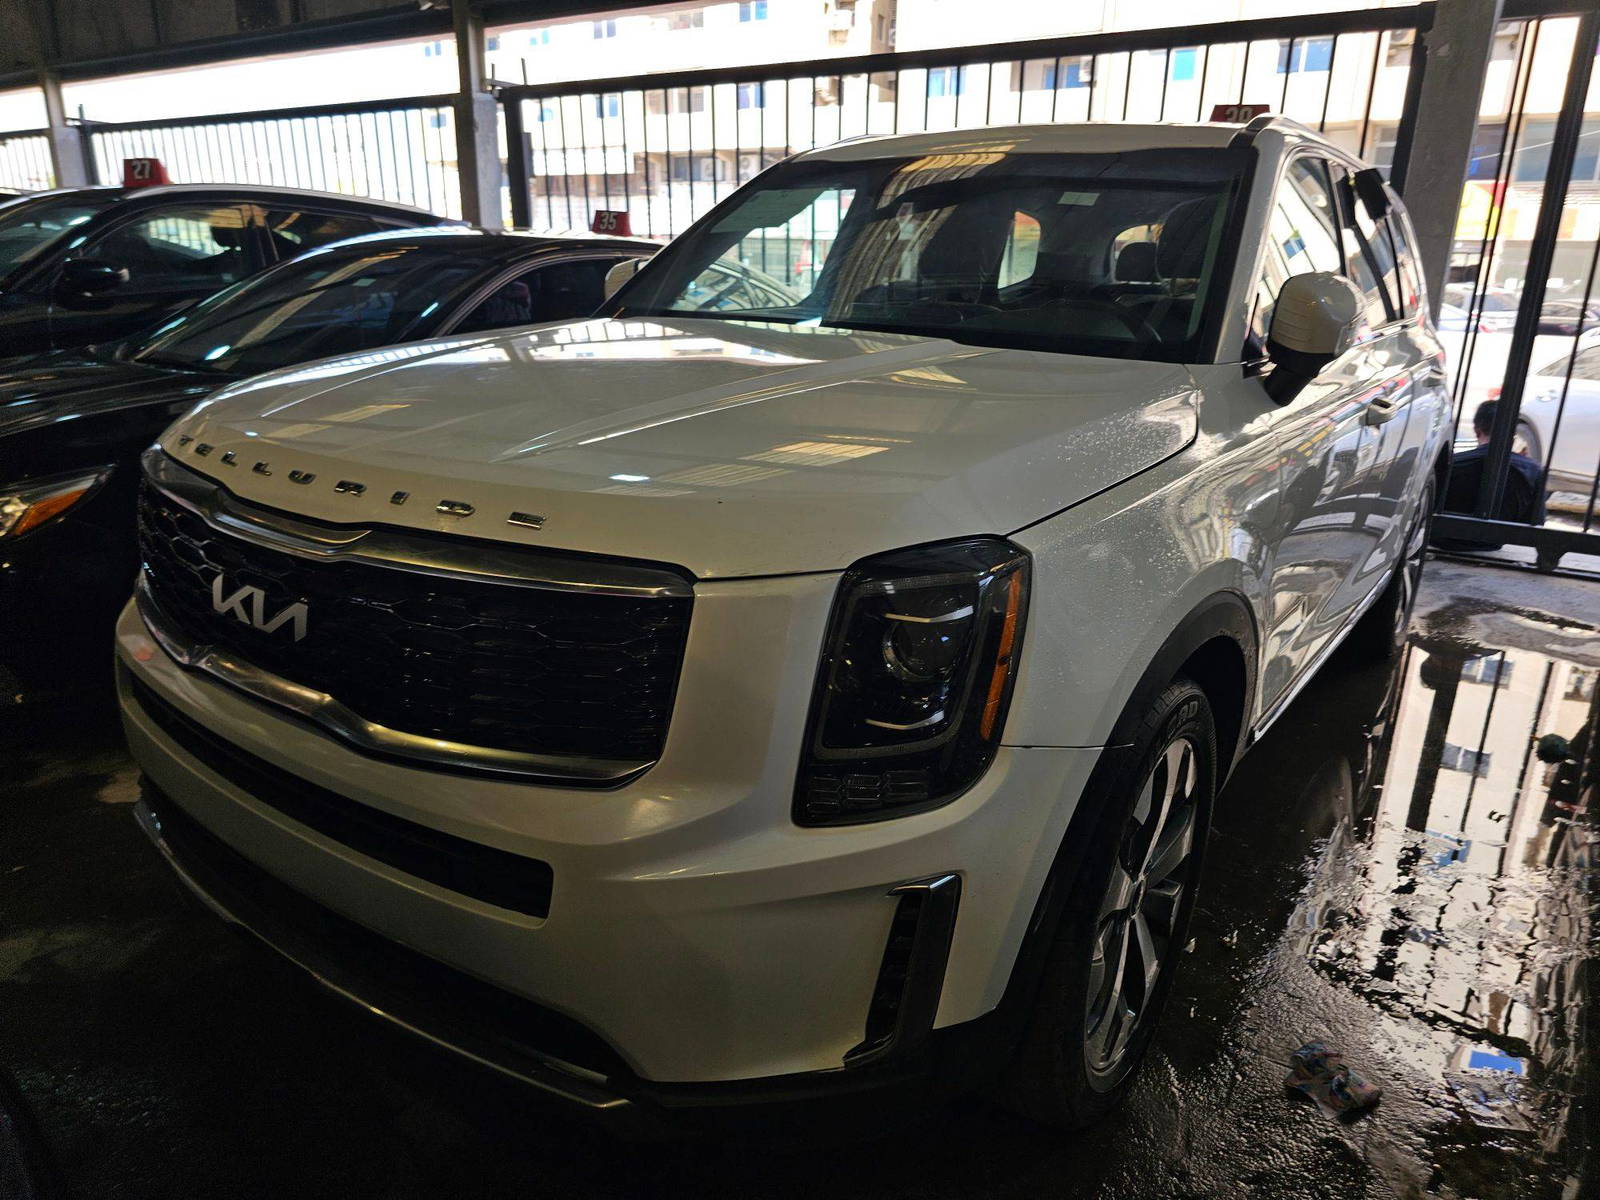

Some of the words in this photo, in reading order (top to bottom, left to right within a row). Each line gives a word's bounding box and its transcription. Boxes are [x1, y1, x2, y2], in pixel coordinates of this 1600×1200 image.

[132, 160, 150, 179] 27
[600, 212, 617, 230] 35
[179, 434, 547, 529] TELLURIDE
[212, 573, 309, 642] KIA
